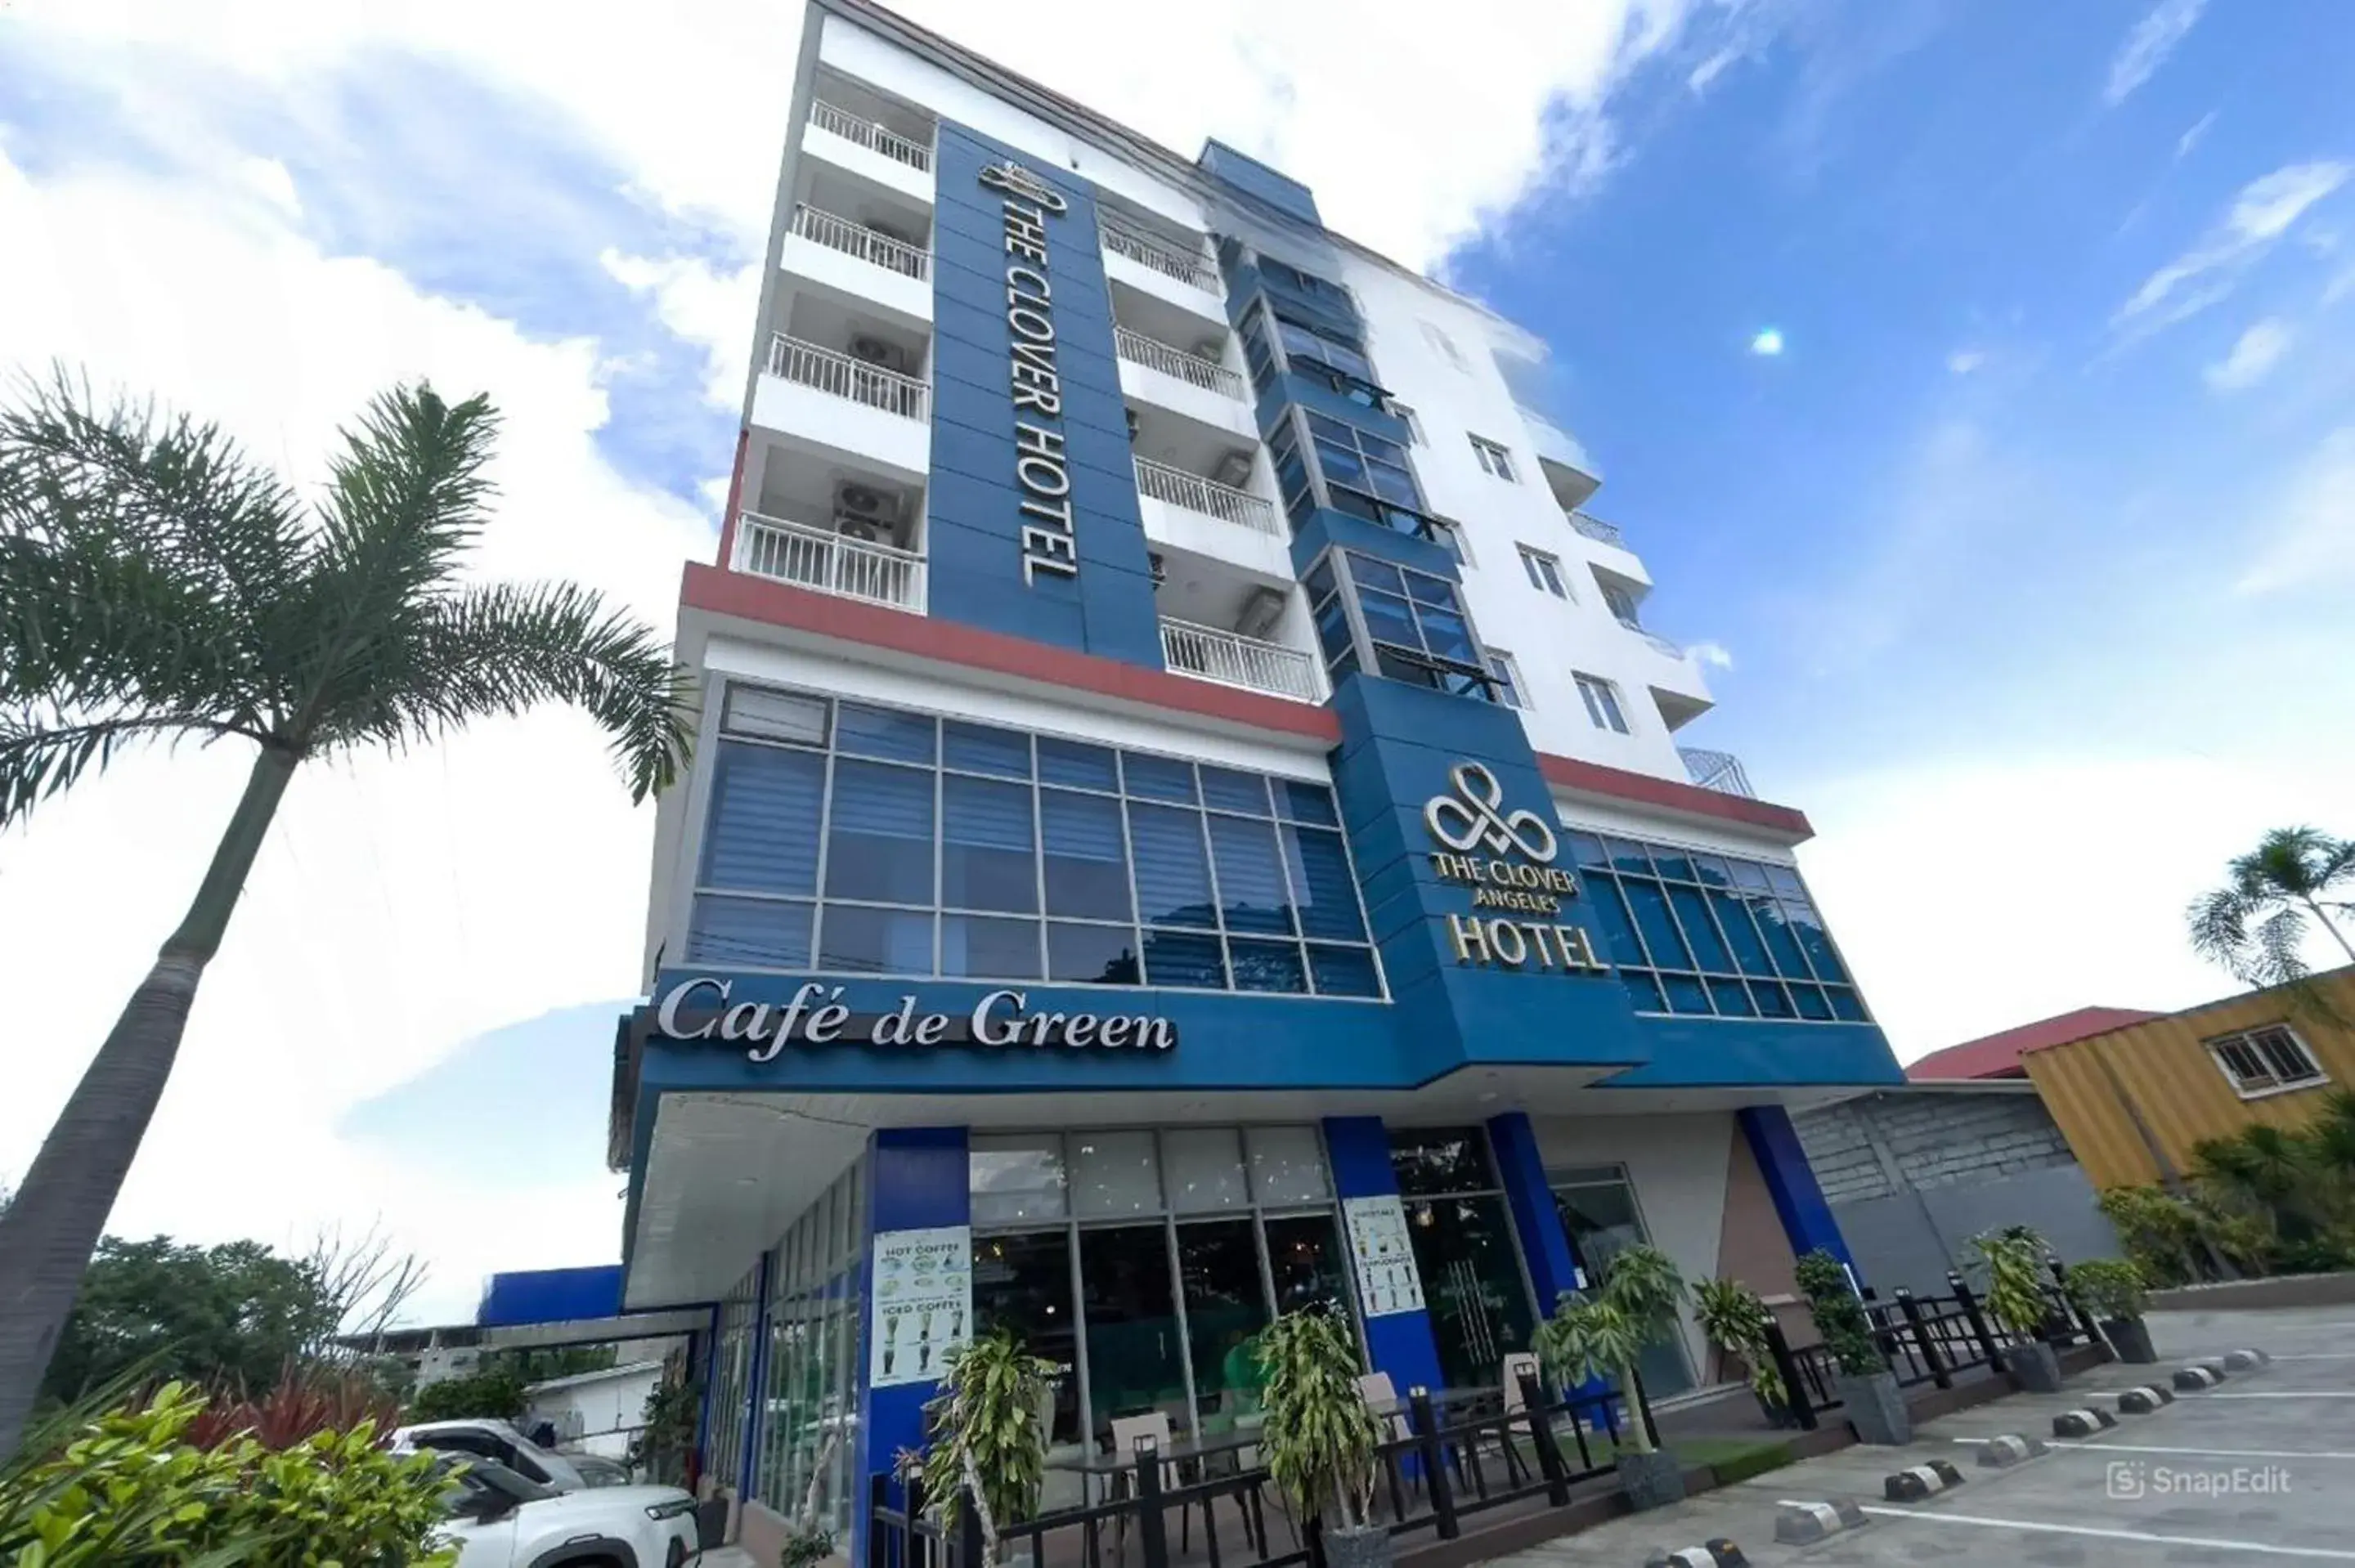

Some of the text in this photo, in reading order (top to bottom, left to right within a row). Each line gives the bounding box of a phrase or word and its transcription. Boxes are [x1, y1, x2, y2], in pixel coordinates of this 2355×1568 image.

[1003, 200, 1078, 589] THE CLOVER HOTEL
[1430, 851, 1577, 894] THE CLOVER
[1474, 888, 1561, 914] ANGELES
[1448, 913, 1611, 970] HOTEL
[657, 978, 1173, 1063] Café de Green
[886, 1243, 959, 1257] HOT COFFEE
